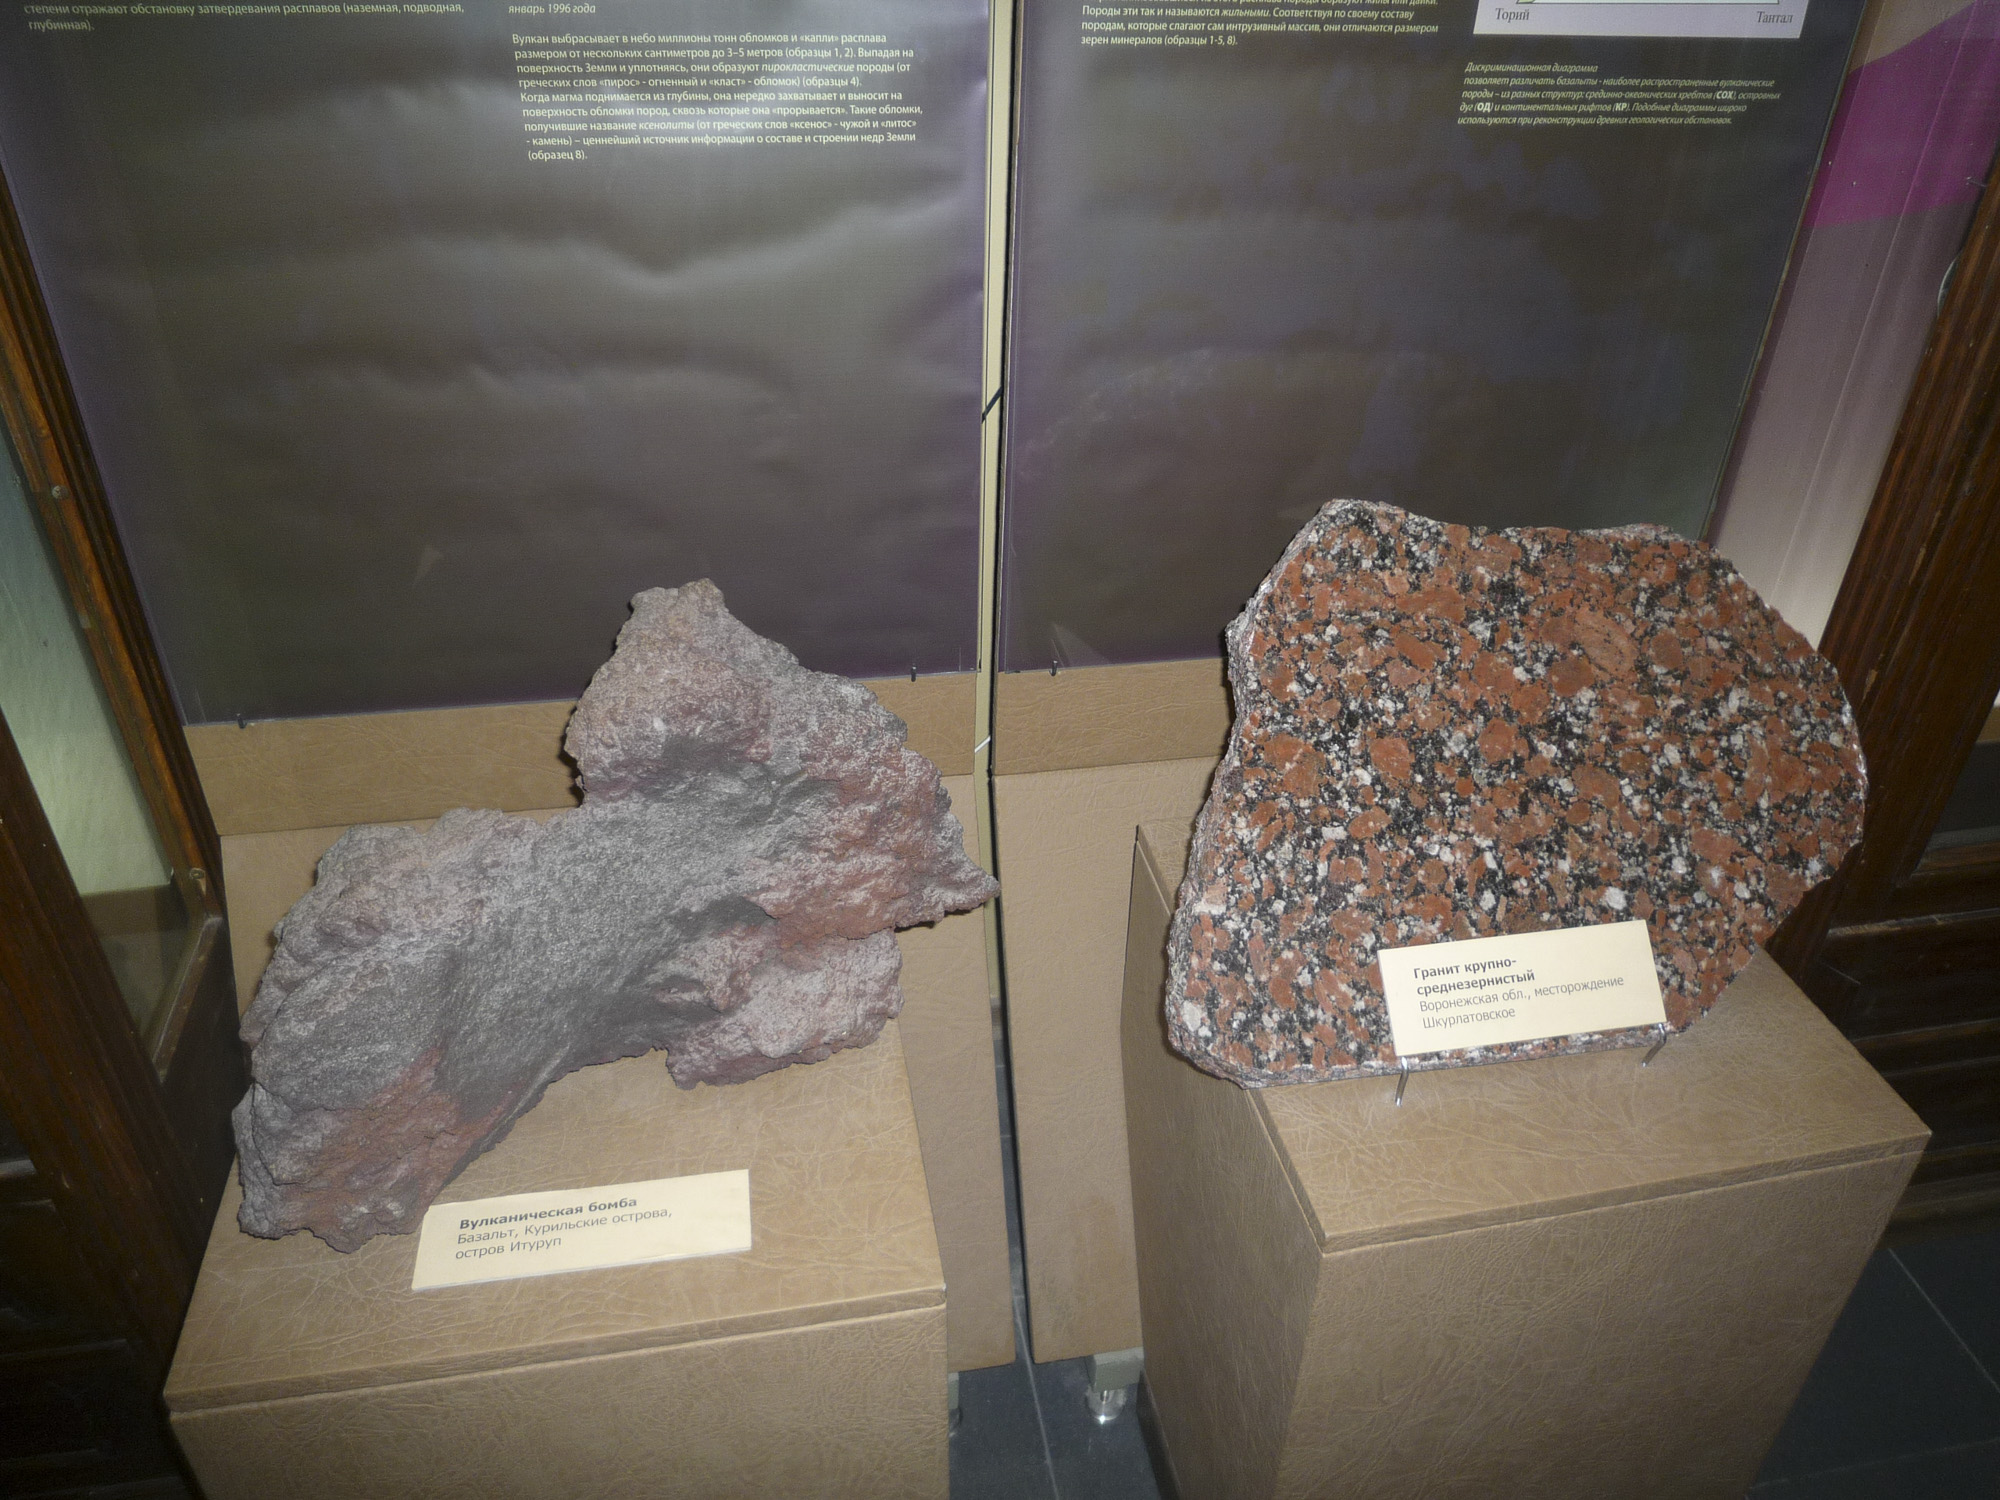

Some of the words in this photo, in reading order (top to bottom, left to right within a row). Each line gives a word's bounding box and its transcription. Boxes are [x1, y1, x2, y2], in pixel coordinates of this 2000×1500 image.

[72, 6, 128, 17] отражают
[131, 3, 195, 16] обстановку
[199, 5, 281, 16] затвердевания
[283, 5, 341, 16] расплавов
[343, 1, 401, 15] (наземная,
[403, 4, 464, 15] подводная,
[508, 5, 545, 16] январь
[548, 3, 571, 14] 1996
[572, 5, 596, 15] года
[1082, 6, 1121, 18] Породы
[1123, 8, 1138, 16] эти
[1140, 8, 1155, 16] так
[1157, 8, 1163, 16] и
[1165, 8, 1219, 17] называются
[1222, 9, 1271, 17] жильными.
[1272, 7, 1332, 20] Соответствуя
[1334, 9, 1345, 18] по
[1347, 10, 1379, 20] своему
[1380, 10, 1414, 20] составу
[1495, 8, 1529, 23] Торий
[1757, 11, 1793, 24] Тантал
[1081, 22, 1125, 33] породам,
[1127, 22, 1167, 33] которые
[1169, 23, 1205, 31] слагают
[1207, 23, 1224, 31] сам
[1226, 20, 1286, 34] интрузивный
[1287, 24, 1321, 34] массив,
[1323, 24, 1340, 32] они
[1342, 24, 1393, 33] отличаются
[1394, 24, 1438, 35] размером
[513, 33, 549, 46] Вулкан
[552, 32, 620, 46] выбрасывает
[623, 35, 628, 43] в
[631, 32, 656, 43] небо
[658, 35, 711, 43] миллионы
[714, 35, 737, 43] тонн
[739, 32, 789, 43] обломков
[791, 34, 798, 43] и
[800, 34, 839, 43] «капли»
[841, 34, 887, 45] расплава
[1081, 36, 1108, 46] зерен
[1110, 36, 1162, 46] минералов
[1164, 33, 1207, 46] (образцы
[1210, 34, 1225, 46] 1-5,
[1227, 33, 1238, 46] 8).
[515, 49, 567, 60] размером
[569, 49, 581, 58] от
[583, 49, 642, 58] нескольких
[645, 49, 710, 60] сантиметров
[712, 49, 725, 60] до
[728, 47, 745, 58] 3–5
[747, 49, 783, 60] метров
[786, 46, 832, 60] (образцы
[834, 46, 842, 59] 1,
[845, 46, 856, 60] 2).
[858, 47, 900, 59] Выпадая
[903, 49, 914, 58] на
[517, 64, 583, 75] поверхность
[586, 62, 617, 72] Земли
[619, 64, 626, 72] и
[628, 64, 688, 74] уплотняясь,
[691, 64, 710, 72] они
[712, 61, 759, 74] образуют
[762, 63, 855, 74] пирокластические
[856, 63, 895, 74] породы
[897, 60, 911, 74] (от
[519, 78, 571, 89] греческих
[573, 78, 597, 87] слов
[599, 78, 640, 89] «пирос»
[648, 75, 698, 87] огненный
[700, 78, 707, 86] и
[709, 78, 746, 86] «класт»
[754, 74, 800, 88] обломок)
[803, 74, 848, 88] (образцы
[850, 74, 861, 88] 4).
[521, 91, 550, 104] Когда
[552, 93, 583, 102] магма
[585, 93, 651, 103] поднимается
[653, 93, 665, 101] из
[667, 90, 711, 103] глубины,
[713, 92, 732, 101] она
[734, 92, 776, 103] нередко
[779, 92, 837, 101] захватывает
[840, 92, 846, 101] и
[848, 92, 889, 101] выносит
[891, 92, 902, 100] на
[523, 107, 588, 118] поверхность
[590, 104, 634, 116] обломки
[672, 107, 706, 115] сквозь
[708, 106, 750, 117] которые
[752, 106, 770, 115] она
[773, 106, 847, 117] «прорывается».
[850, 104, 877, 114] Такие
[879, 103, 923, 116] обломки,
[524, 122, 588, 133] получившие
[590, 121, 637, 130] название
[639, 121, 695, 130] ксенолиты
[697, 118, 710, 132] (от
[713, 121, 763, 132] греческих
[765, 120, 788, 129] слов
[790, 120, 832, 129] «ксенос»
[840, 117, 871, 131] чужой
[872, 120, 879, 129] и
[881, 120, 917, 129] «литос»
[533, 133, 572, 147] камень)
[583, 132, 641, 146] ценнейший
[643, 135, 689, 144] источник
[692, 131, 755, 145] информации
[757, 134, 763, 143] о
[765, 134, 803, 142] составе
[805, 133, 811, 142] и
[813, 133, 859, 144] строении
[861, 133, 885, 144] недр
[887, 130, 916, 141] Земли
[528, 148, 574, 162] (образец
[576, 148, 587, 162] 8).
[1414, 964, 1460, 980] Гранит
[1464, 958, 1517, 975] крупно-
[1417, 970, 1535, 998] среднезернистый
[1419, 992, 1498, 1013] Воронежская
[1502, 987, 1531, 1002] обл.,
[1535, 975, 1624, 997] месторождение
[1422, 1007, 1515, 1029] Шкурлатовское
[459, 1205, 584, 1230] Вулканическая
[588, 1197, 637, 1213] бомба
[457, 1229, 518, 1245] Базальт,
[524, 1216, 607, 1236] Курильские
[612, 1208, 672, 1226] острова,
[455, 1244, 504, 1261] остров
[510, 1237, 562, 1254] Итуруп
